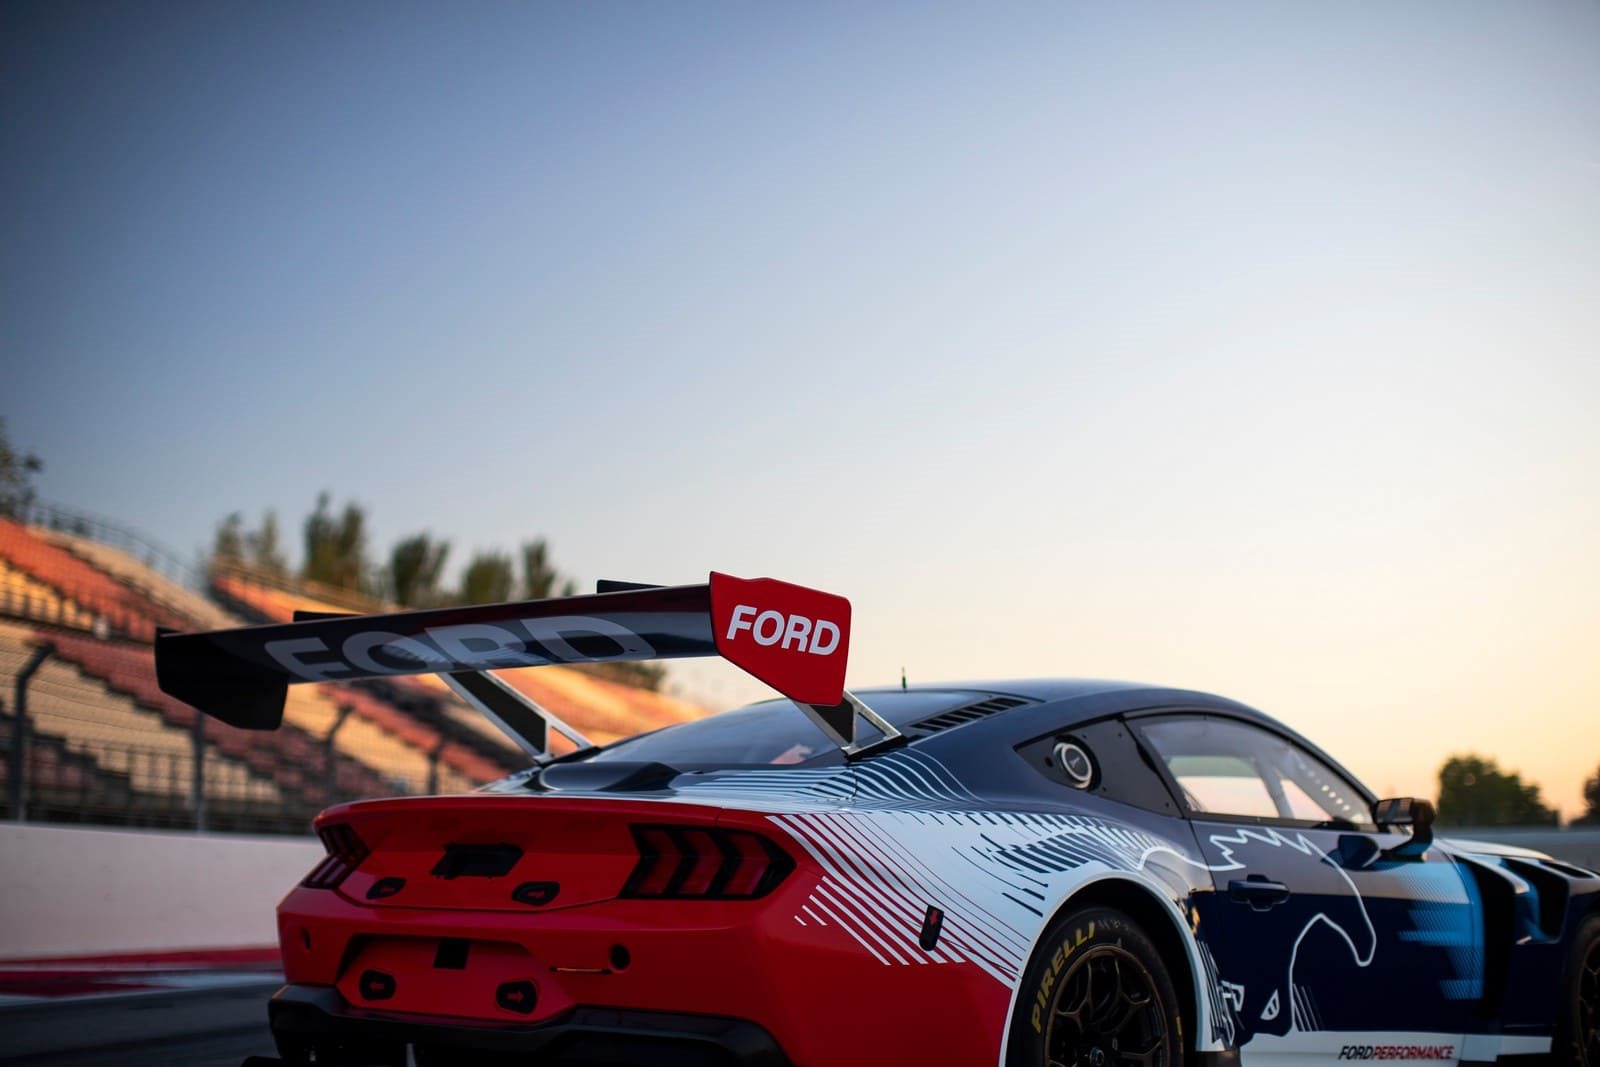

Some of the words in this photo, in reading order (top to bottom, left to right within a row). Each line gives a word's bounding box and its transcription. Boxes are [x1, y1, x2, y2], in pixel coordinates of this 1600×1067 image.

[264, 615, 656, 682] FORD
[726, 604, 841, 656] FORD
[1031, 921, 1096, 1034] PIRELLI
